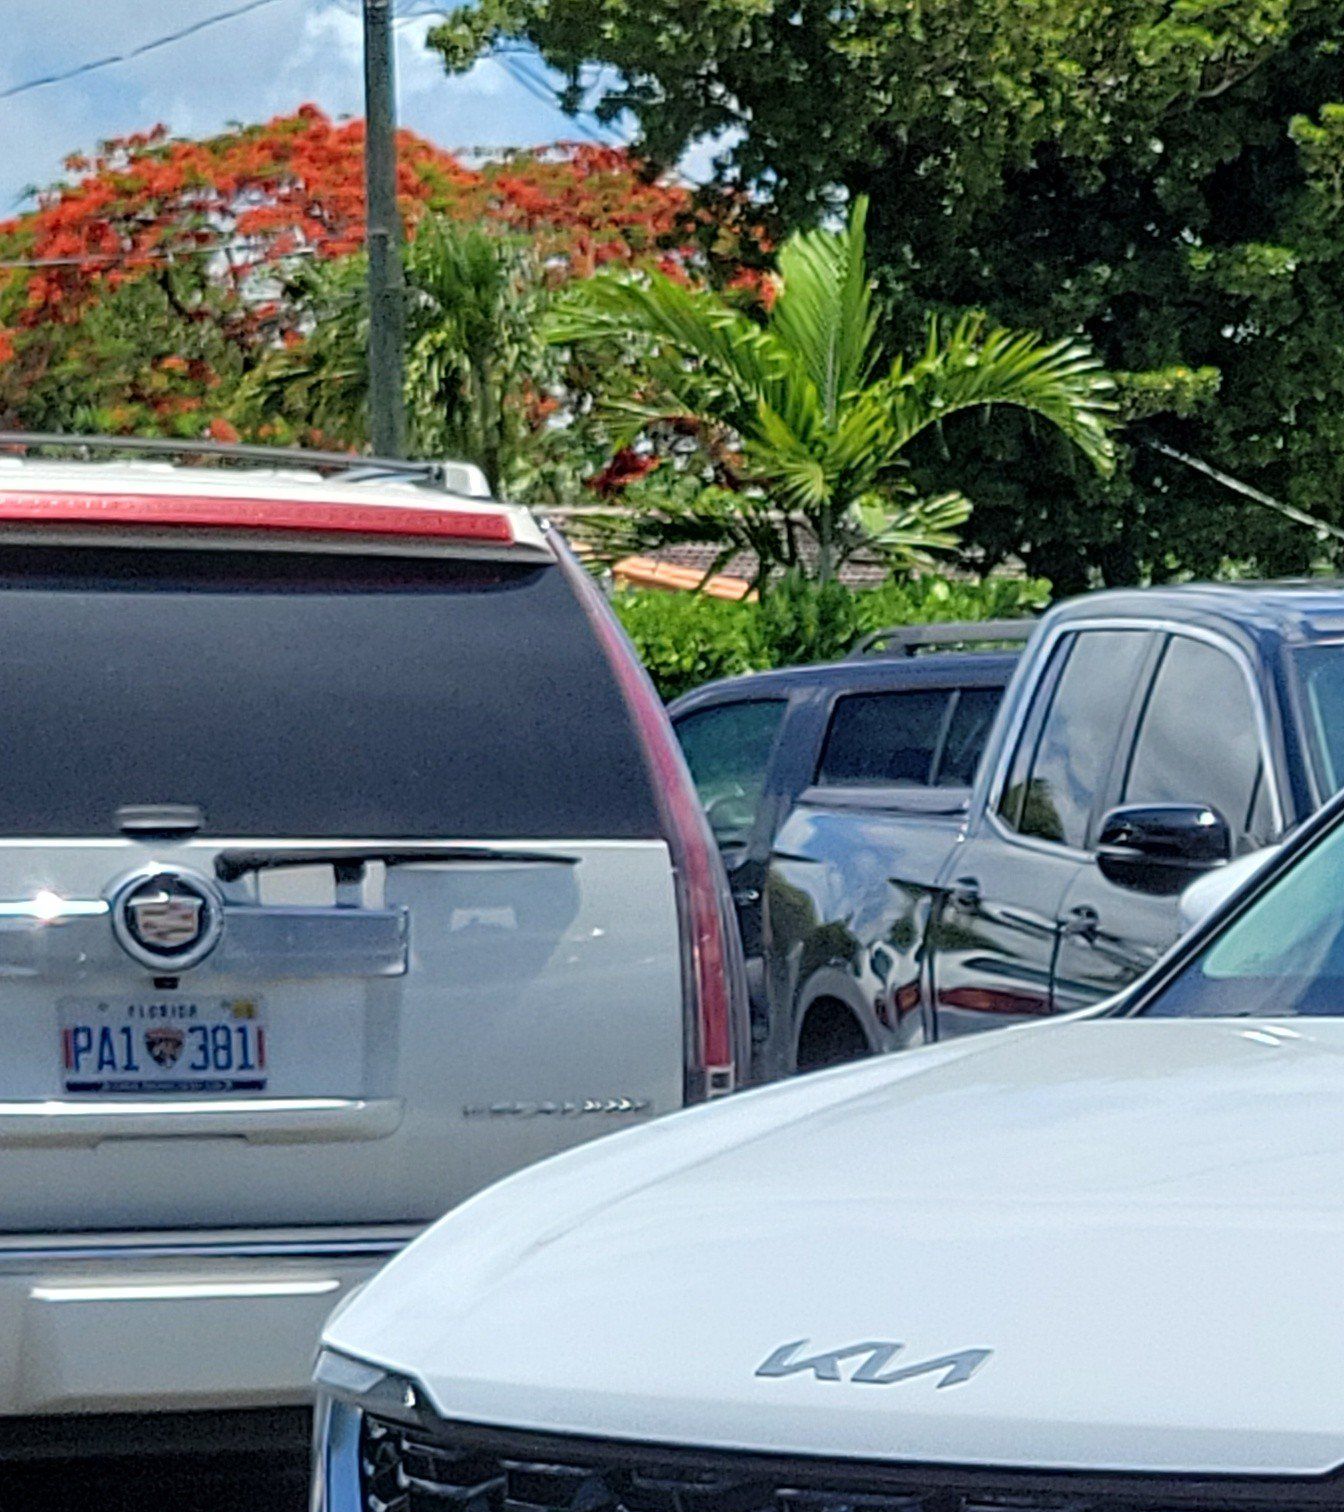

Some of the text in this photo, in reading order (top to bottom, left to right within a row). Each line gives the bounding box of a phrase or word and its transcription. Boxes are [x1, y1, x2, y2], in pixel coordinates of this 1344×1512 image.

[72, 1023, 256, 1073] PA1 381
[754, 1337, 995, 1390] KIA
